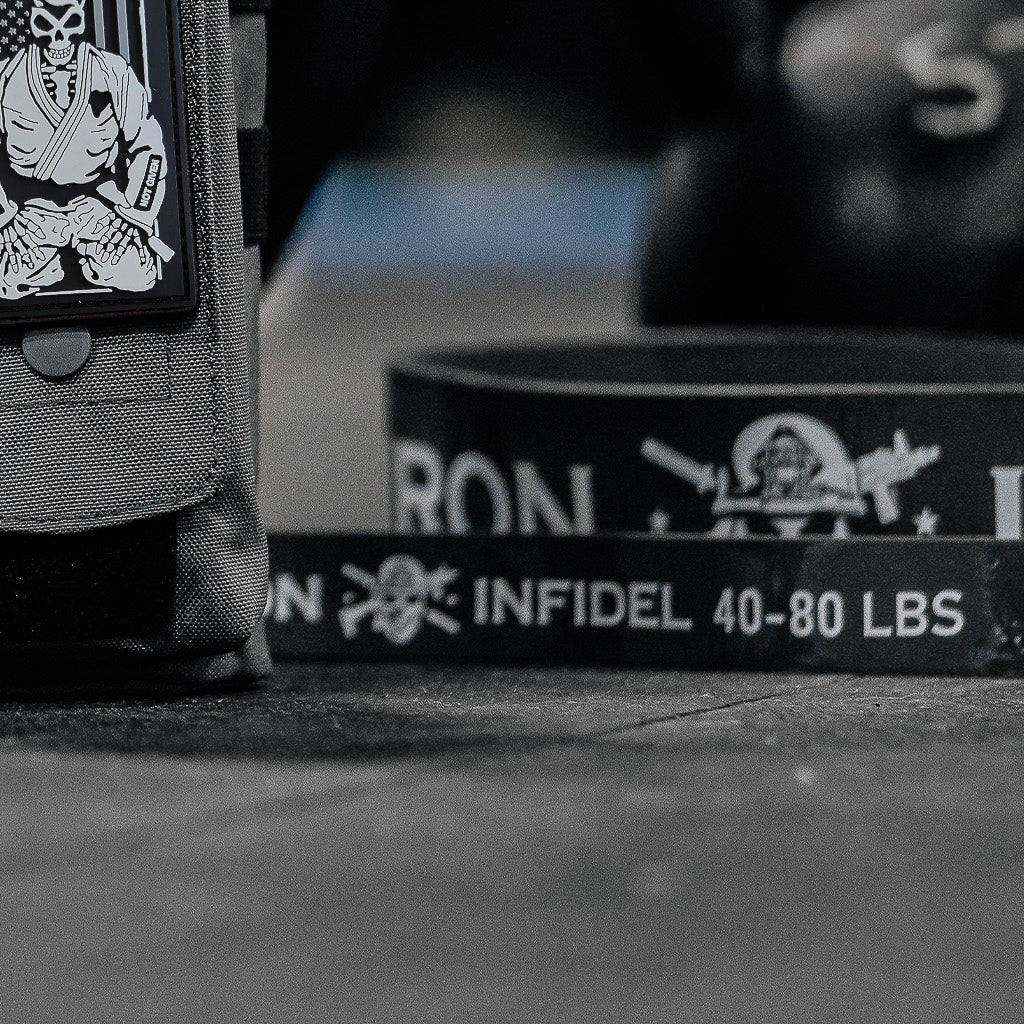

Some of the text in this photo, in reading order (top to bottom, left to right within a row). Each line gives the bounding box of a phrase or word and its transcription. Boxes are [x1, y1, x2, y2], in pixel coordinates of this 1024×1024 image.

[139, 159, 161, 207] NOT GIVEN
[473, 577, 694, 633] INFIDEL
[712, 586, 844, 640] 40-80
[861, 589, 967, 640] LBS
